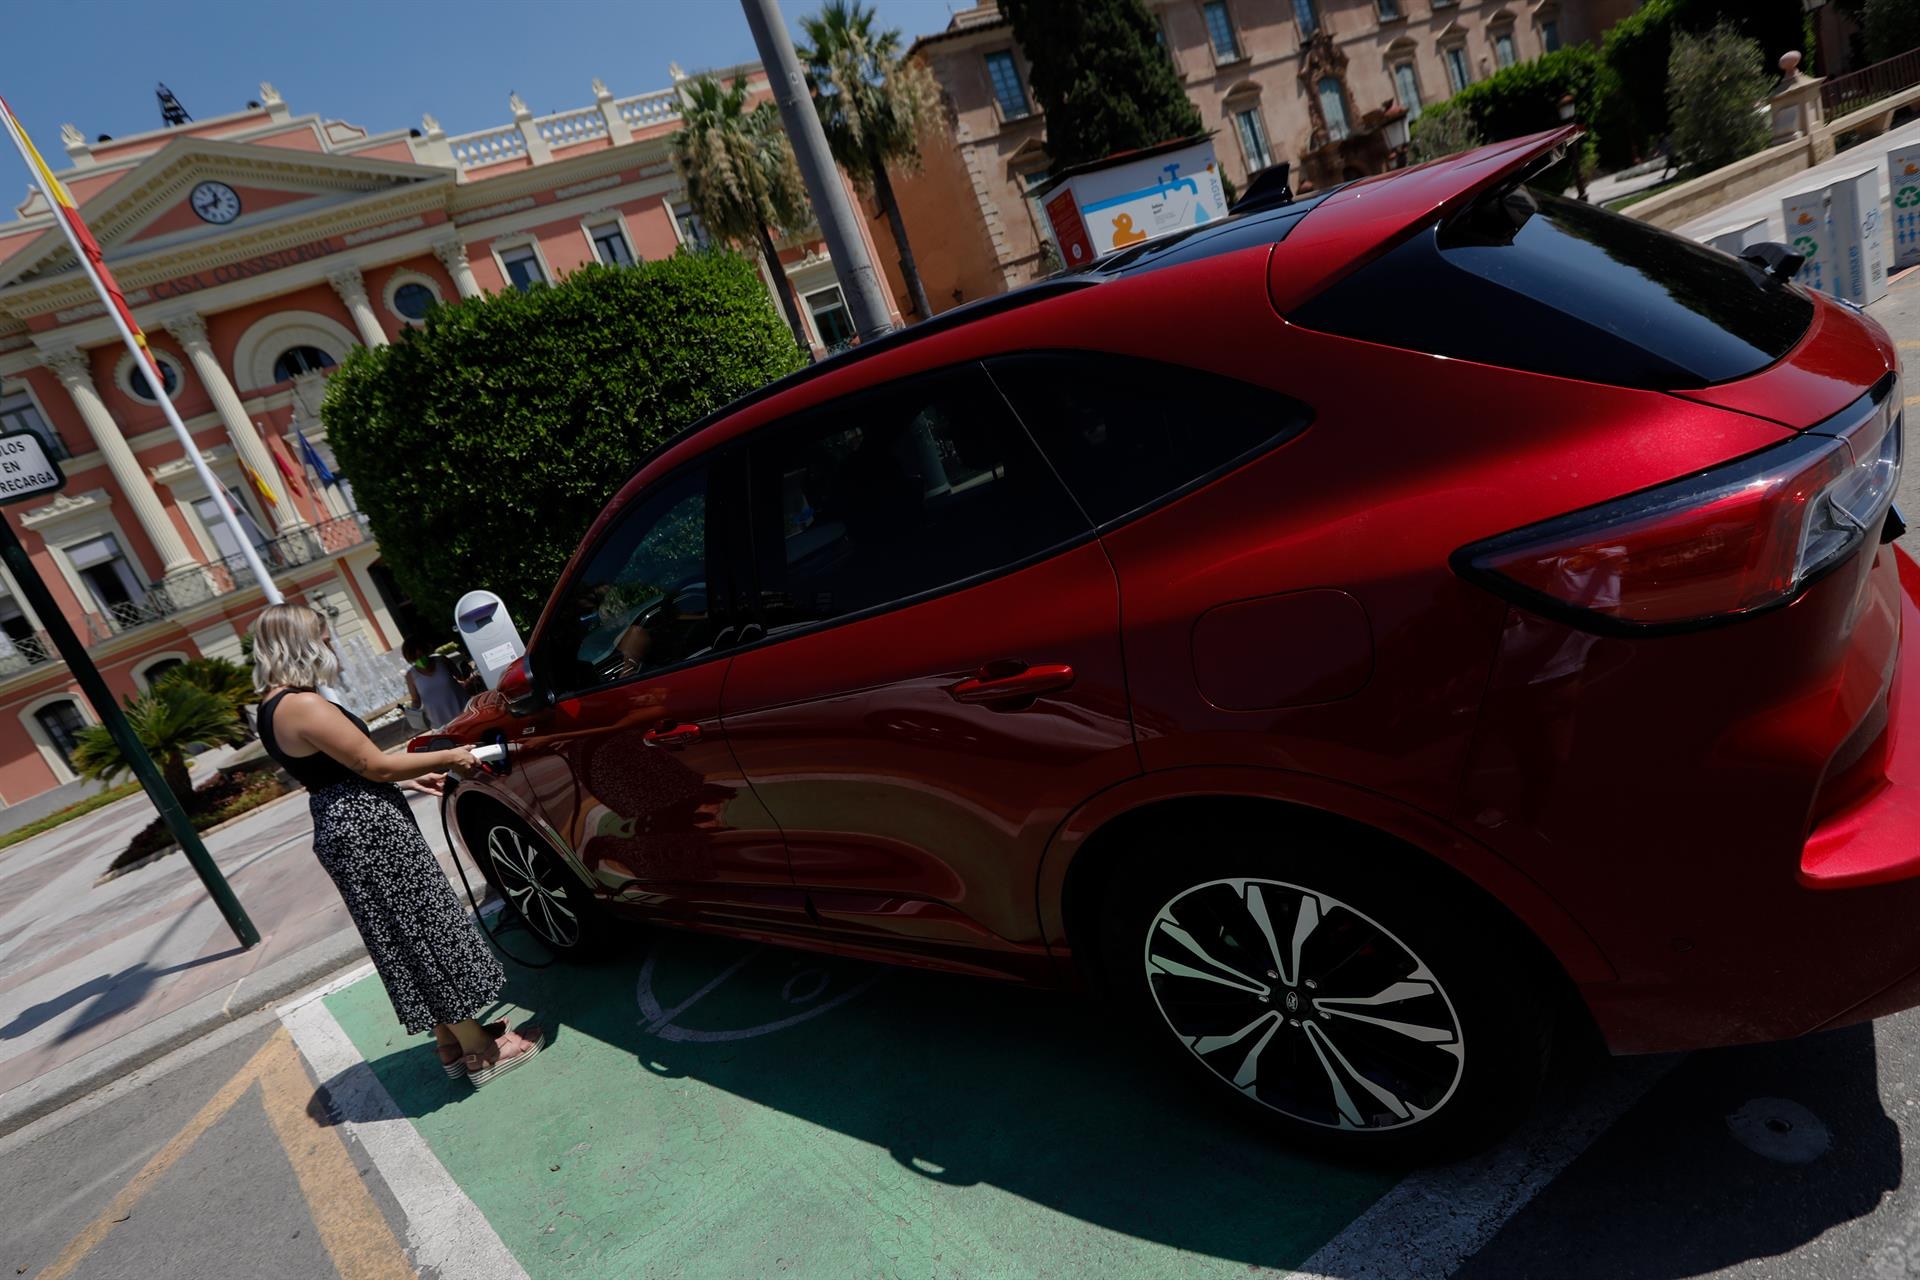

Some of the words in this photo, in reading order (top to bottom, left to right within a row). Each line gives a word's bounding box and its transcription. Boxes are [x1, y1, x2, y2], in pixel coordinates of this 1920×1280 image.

[1210, 178, 1224, 209] AGUA
[154, 275, 209, 299] CASA
[0, 441, 26, 457] LOS
[2, 461, 21, 473] EN
[0, 471, 55, 493] RECARGA
